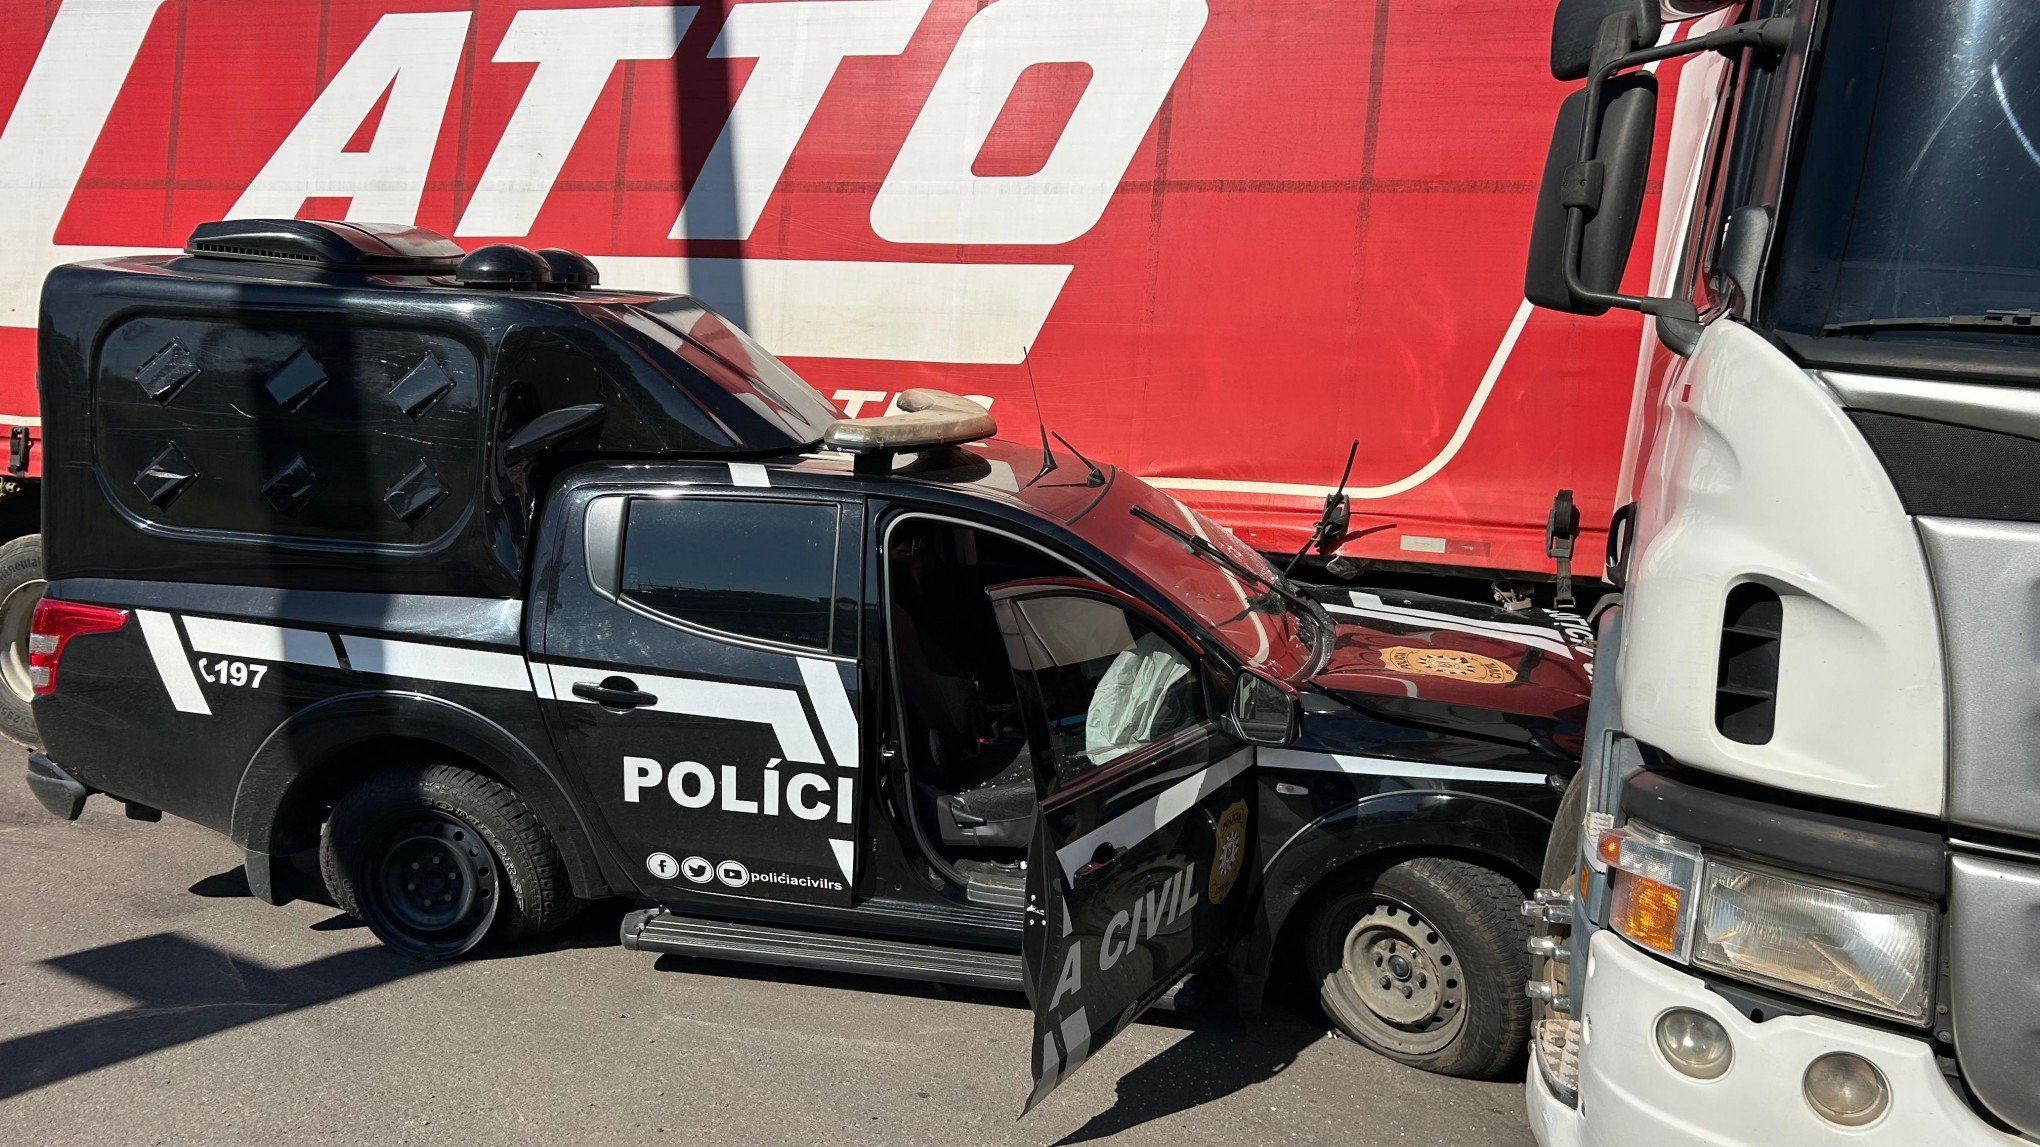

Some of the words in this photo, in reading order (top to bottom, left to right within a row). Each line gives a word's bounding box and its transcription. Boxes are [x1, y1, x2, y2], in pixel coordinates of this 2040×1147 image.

[214, 659, 268, 689] 197
[623, 756, 854, 824] POLÍCI
[1049, 939, 1082, 1012] A
[1099, 862, 1199, 971] CIVIL
